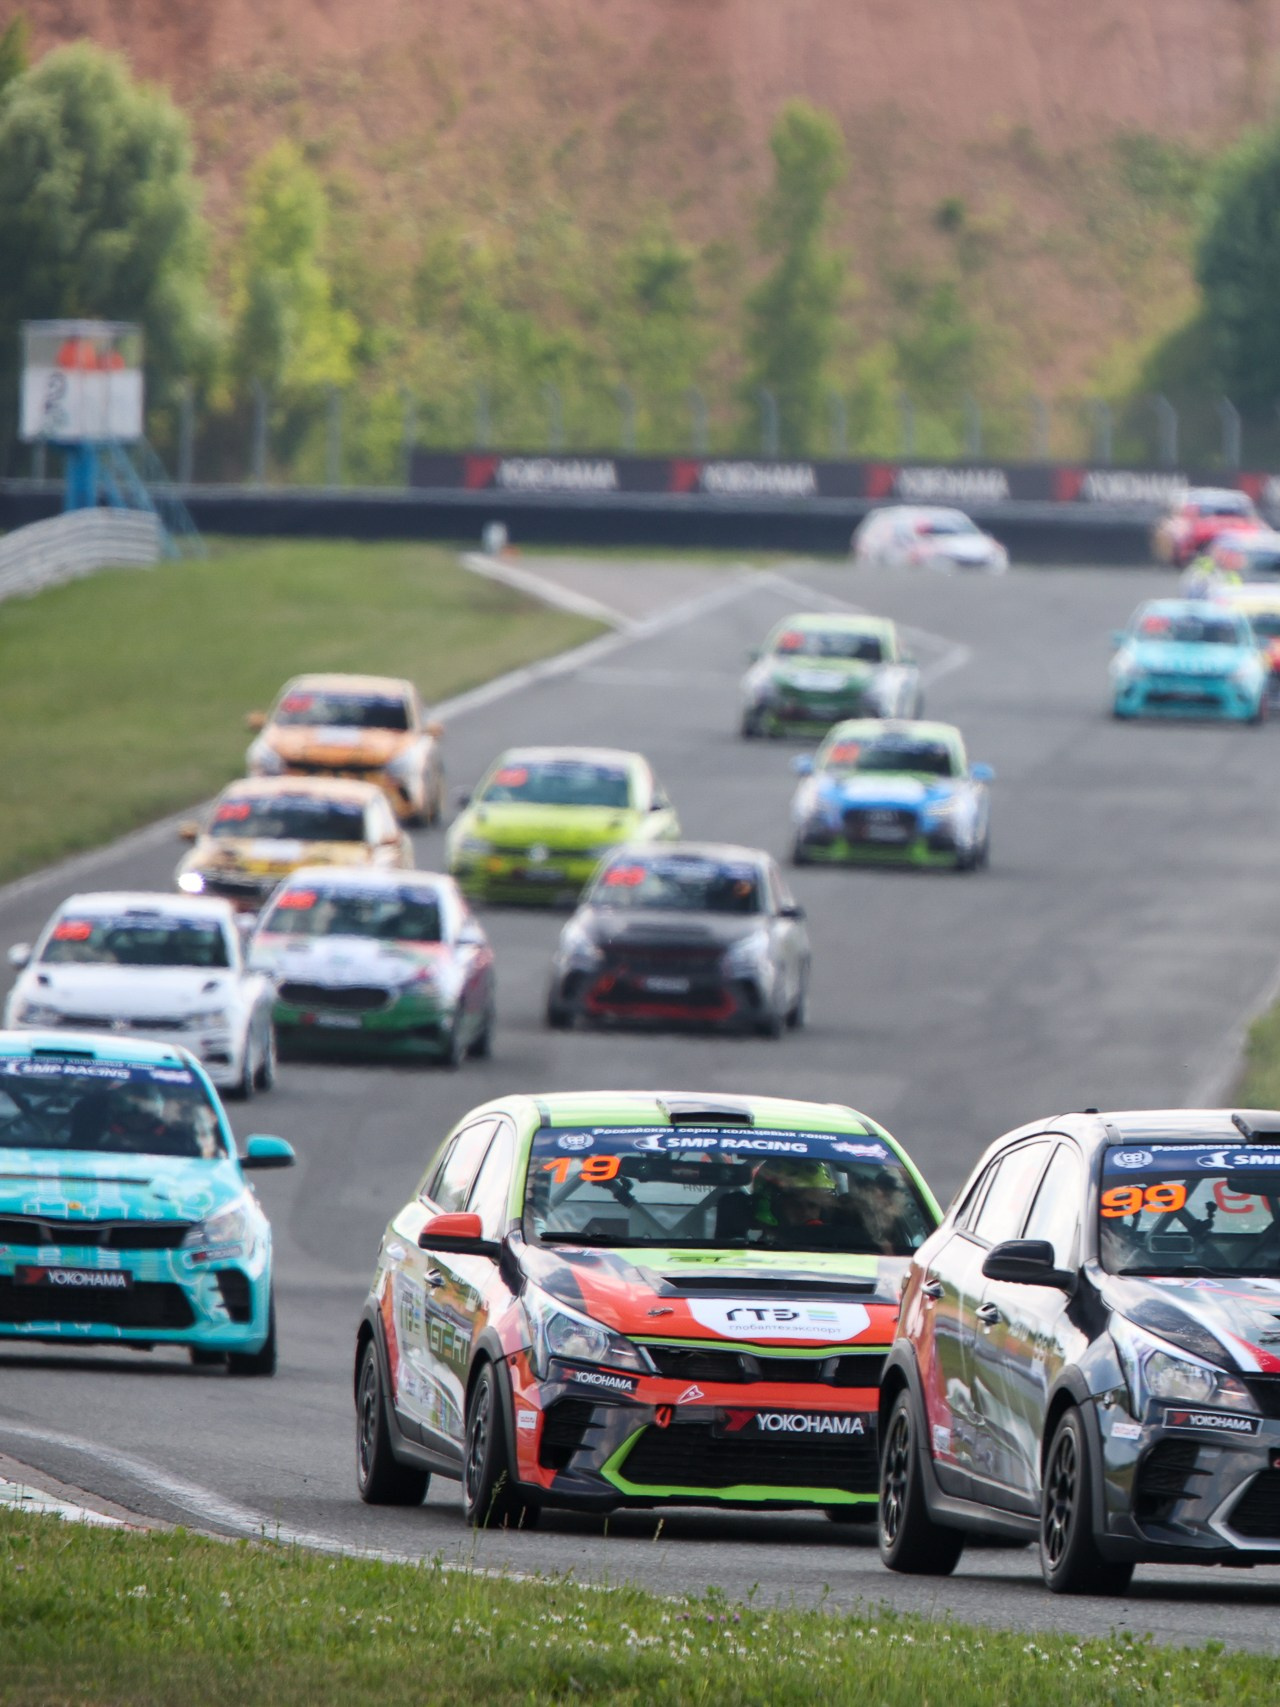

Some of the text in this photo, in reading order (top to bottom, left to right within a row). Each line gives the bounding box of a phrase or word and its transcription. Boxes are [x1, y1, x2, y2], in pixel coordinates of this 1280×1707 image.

[64, 1065, 130, 1079] RACING
[666, 1138, 808, 1153] SMP RACING
[542, 1154, 621, 1184] 19
[1101, 1183, 1188, 1218] 99
[48, 1270, 127, 1287] YOKOHAMA
[575, 1371, 633, 1391] YOKOHAMA
[756, 1413, 865, 1435] YOKOHAMA
[1188, 1414, 1253, 1431] YOKOHAMA
